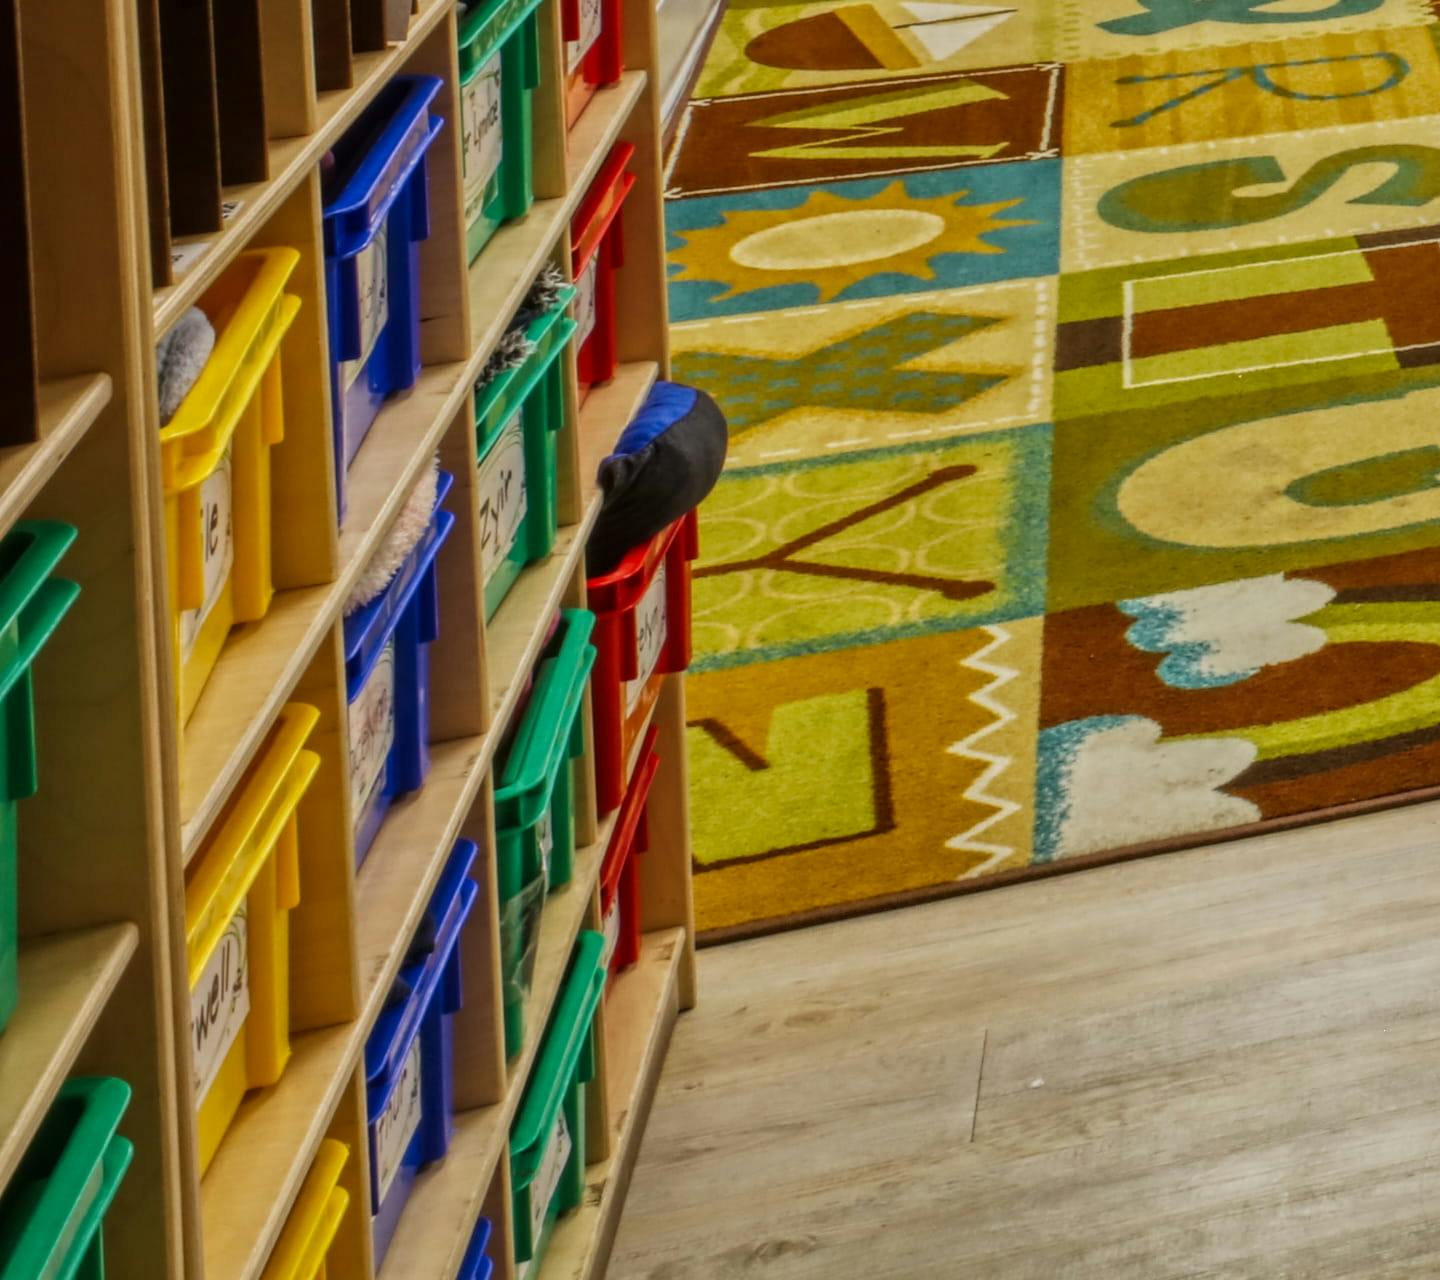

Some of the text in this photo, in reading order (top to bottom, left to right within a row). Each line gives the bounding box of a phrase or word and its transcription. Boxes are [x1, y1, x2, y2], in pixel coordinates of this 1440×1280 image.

[1110, 49, 1412, 129] R
[692, 464, 997, 600] Y
[191, 938, 232, 1053] well
